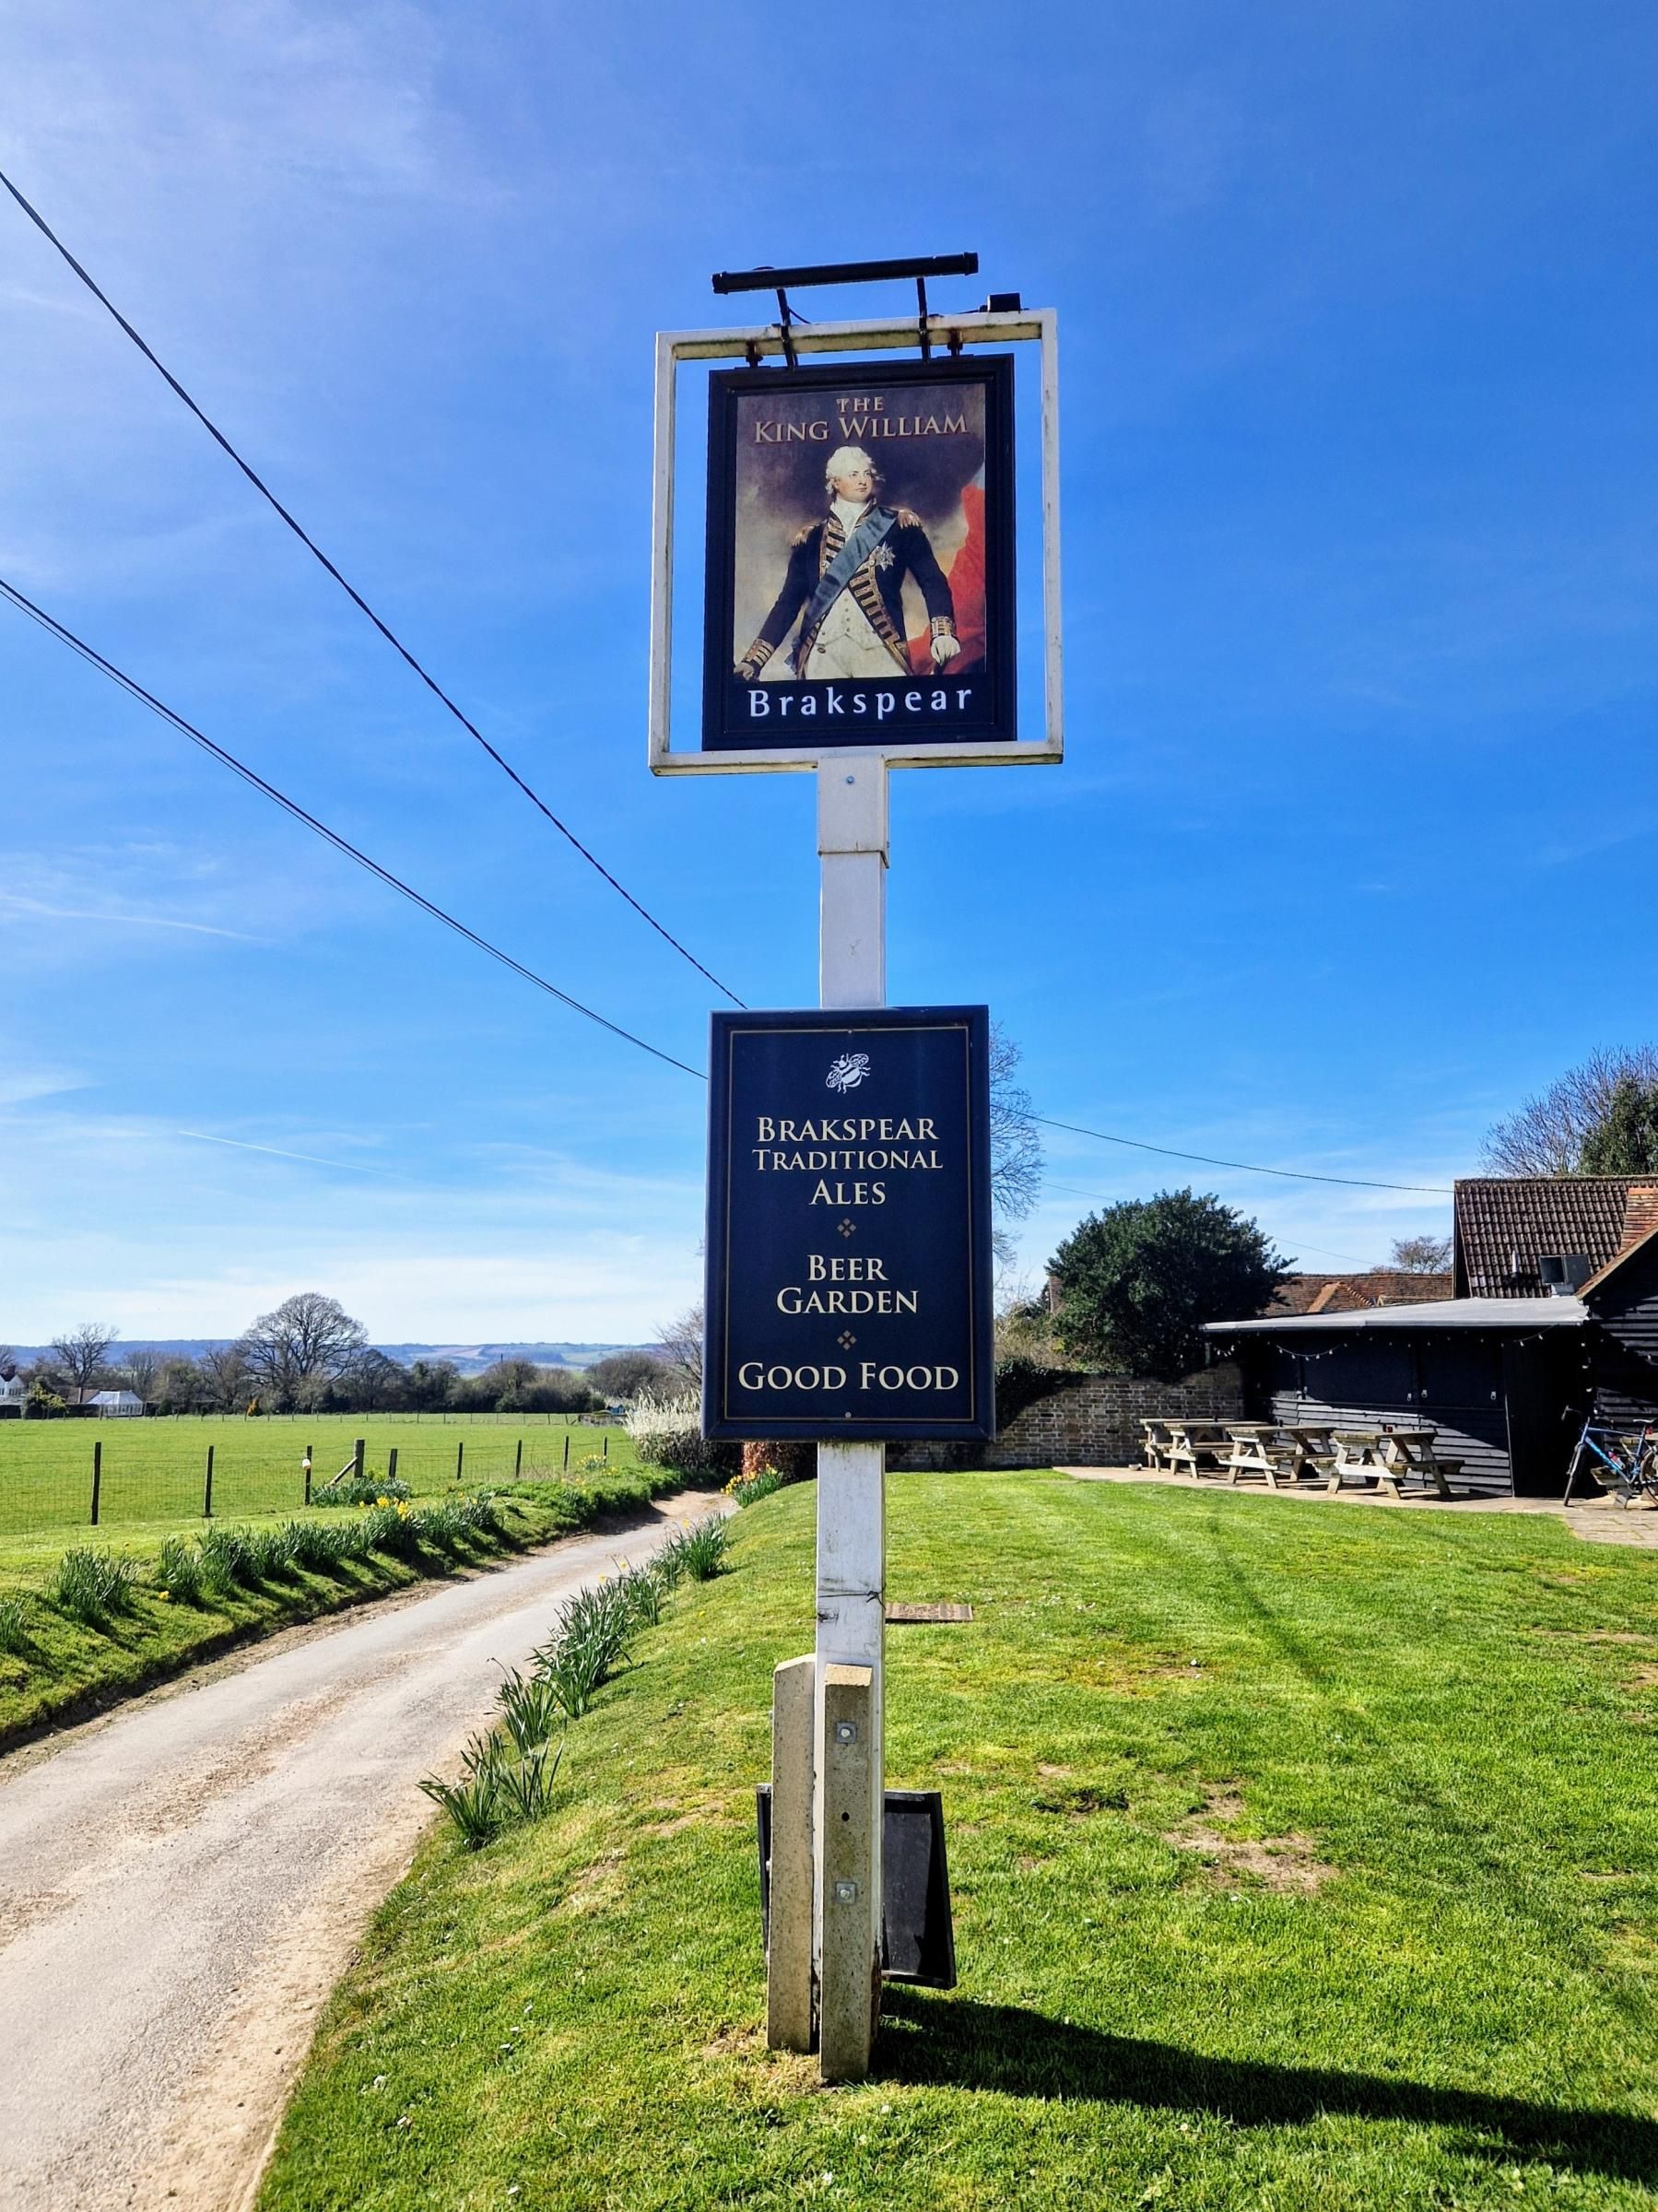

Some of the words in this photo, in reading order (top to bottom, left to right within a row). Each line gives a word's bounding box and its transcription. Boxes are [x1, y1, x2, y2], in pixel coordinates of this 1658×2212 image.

[836, 396, 885, 413] THE
[754, 419, 829, 443] KING
[838, 413, 969, 439] WILLIAM
[747, 686, 972, 720] Brakspear
[757, 1117, 939, 1142] BRAKSPEAR
[752, 1148, 943, 1171] TRADITIONAL
[808, 1180, 886, 1206] ALES
[807, 1254, 888, 1281] BEER
[776, 1287, 918, 1314] GARDEN
[738, 1362, 847, 1390] GOOD
[859, 1362, 958, 1390] FOOD
